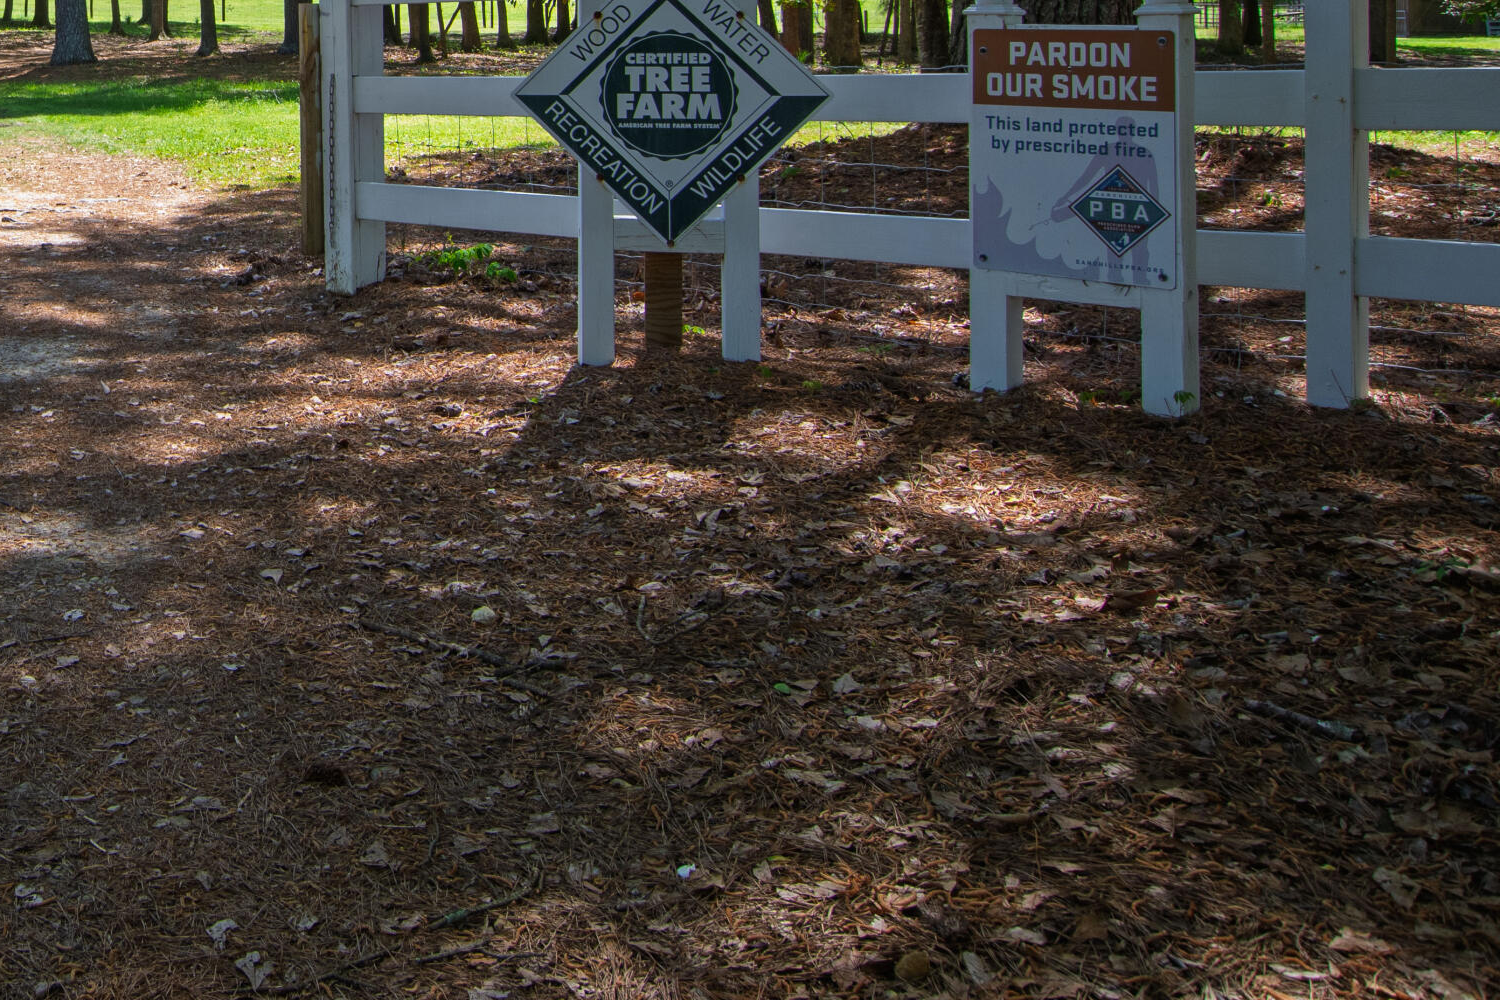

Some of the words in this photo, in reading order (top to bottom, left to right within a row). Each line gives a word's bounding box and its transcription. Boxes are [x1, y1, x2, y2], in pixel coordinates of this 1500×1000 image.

[569, 4, 632, 63] WOOD
[625, 52, 712, 65] CERTIFIED
[1009, 41, 1131, 68] PARDON
[624, 66, 711, 92] TREE
[986, 72, 1044, 98] OUR
[1052, 74, 1157, 102] SMOKE
[616, 93, 722, 120] FARM
[985, 115, 1021, 131] This
[1026, 117, 1063, 133] land
[1069, 121, 1159, 138] protected
[544, 100, 664, 215] RECREATION
[690, 115, 783, 200] WILDLIFE
[991, 135, 1010, 154] by
[1015, 138, 1109, 156] prescribed
[1114, 141, 1153, 158] fire.
